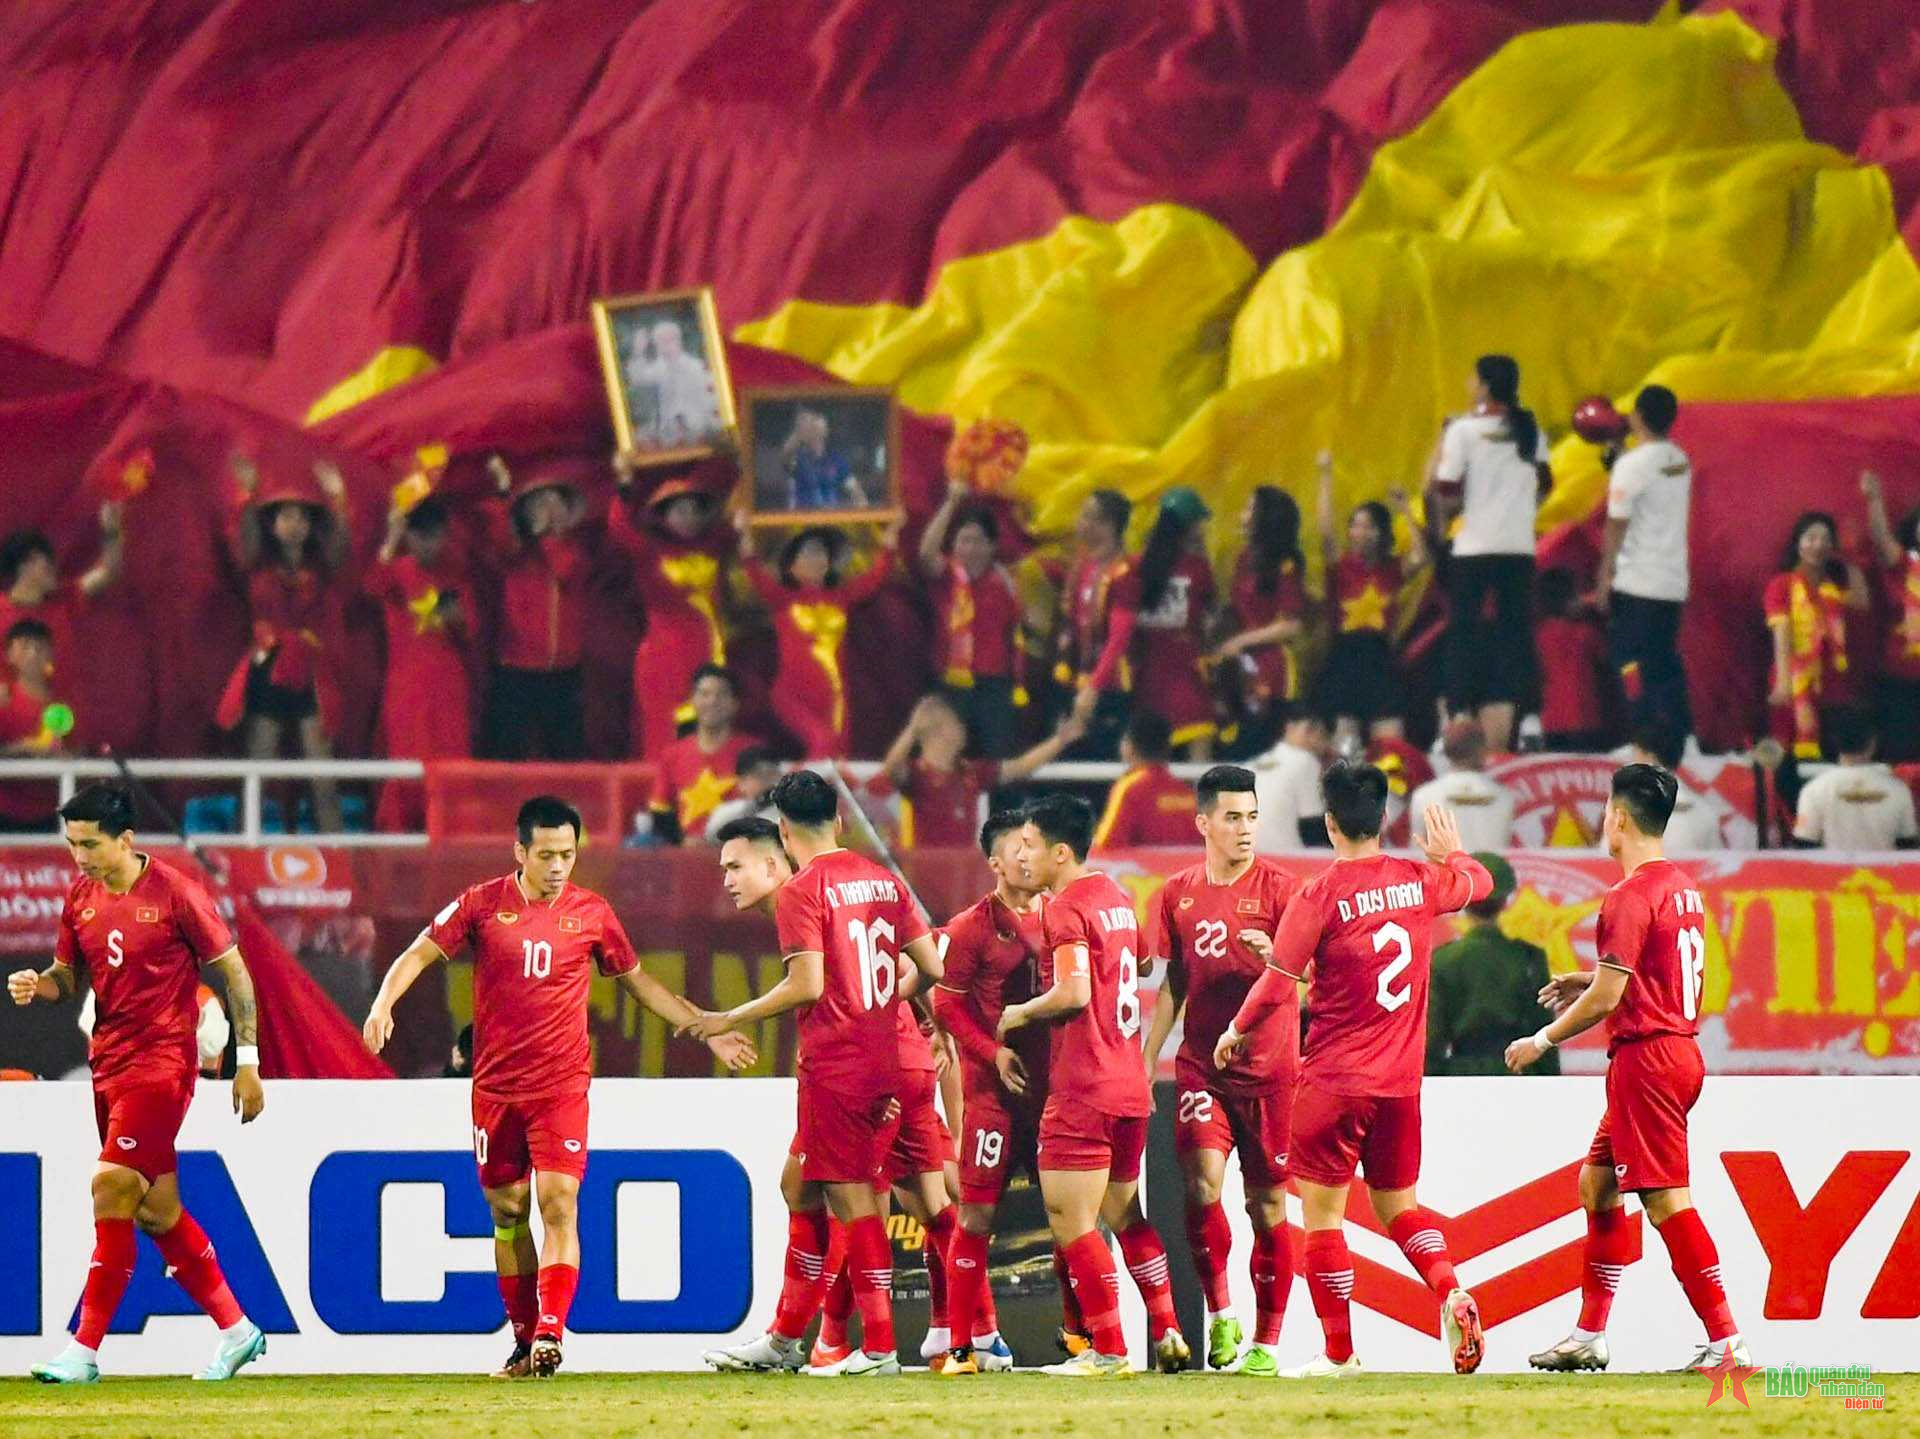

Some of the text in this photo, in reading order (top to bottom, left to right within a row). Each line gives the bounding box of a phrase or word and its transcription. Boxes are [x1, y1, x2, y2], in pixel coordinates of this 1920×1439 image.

[1355, 888, 1385, 917] DUY
[1194, 919, 1228, 959] 22
[522, 940, 552, 979] 10
[849, 916, 896, 1011] 16
[1372, 920, 1413, 1013] 2
[1116, 945, 1140, 1040] 8
[1179, 1090, 1214, 1125] 22
[975, 1128, 1004, 1169] 19
